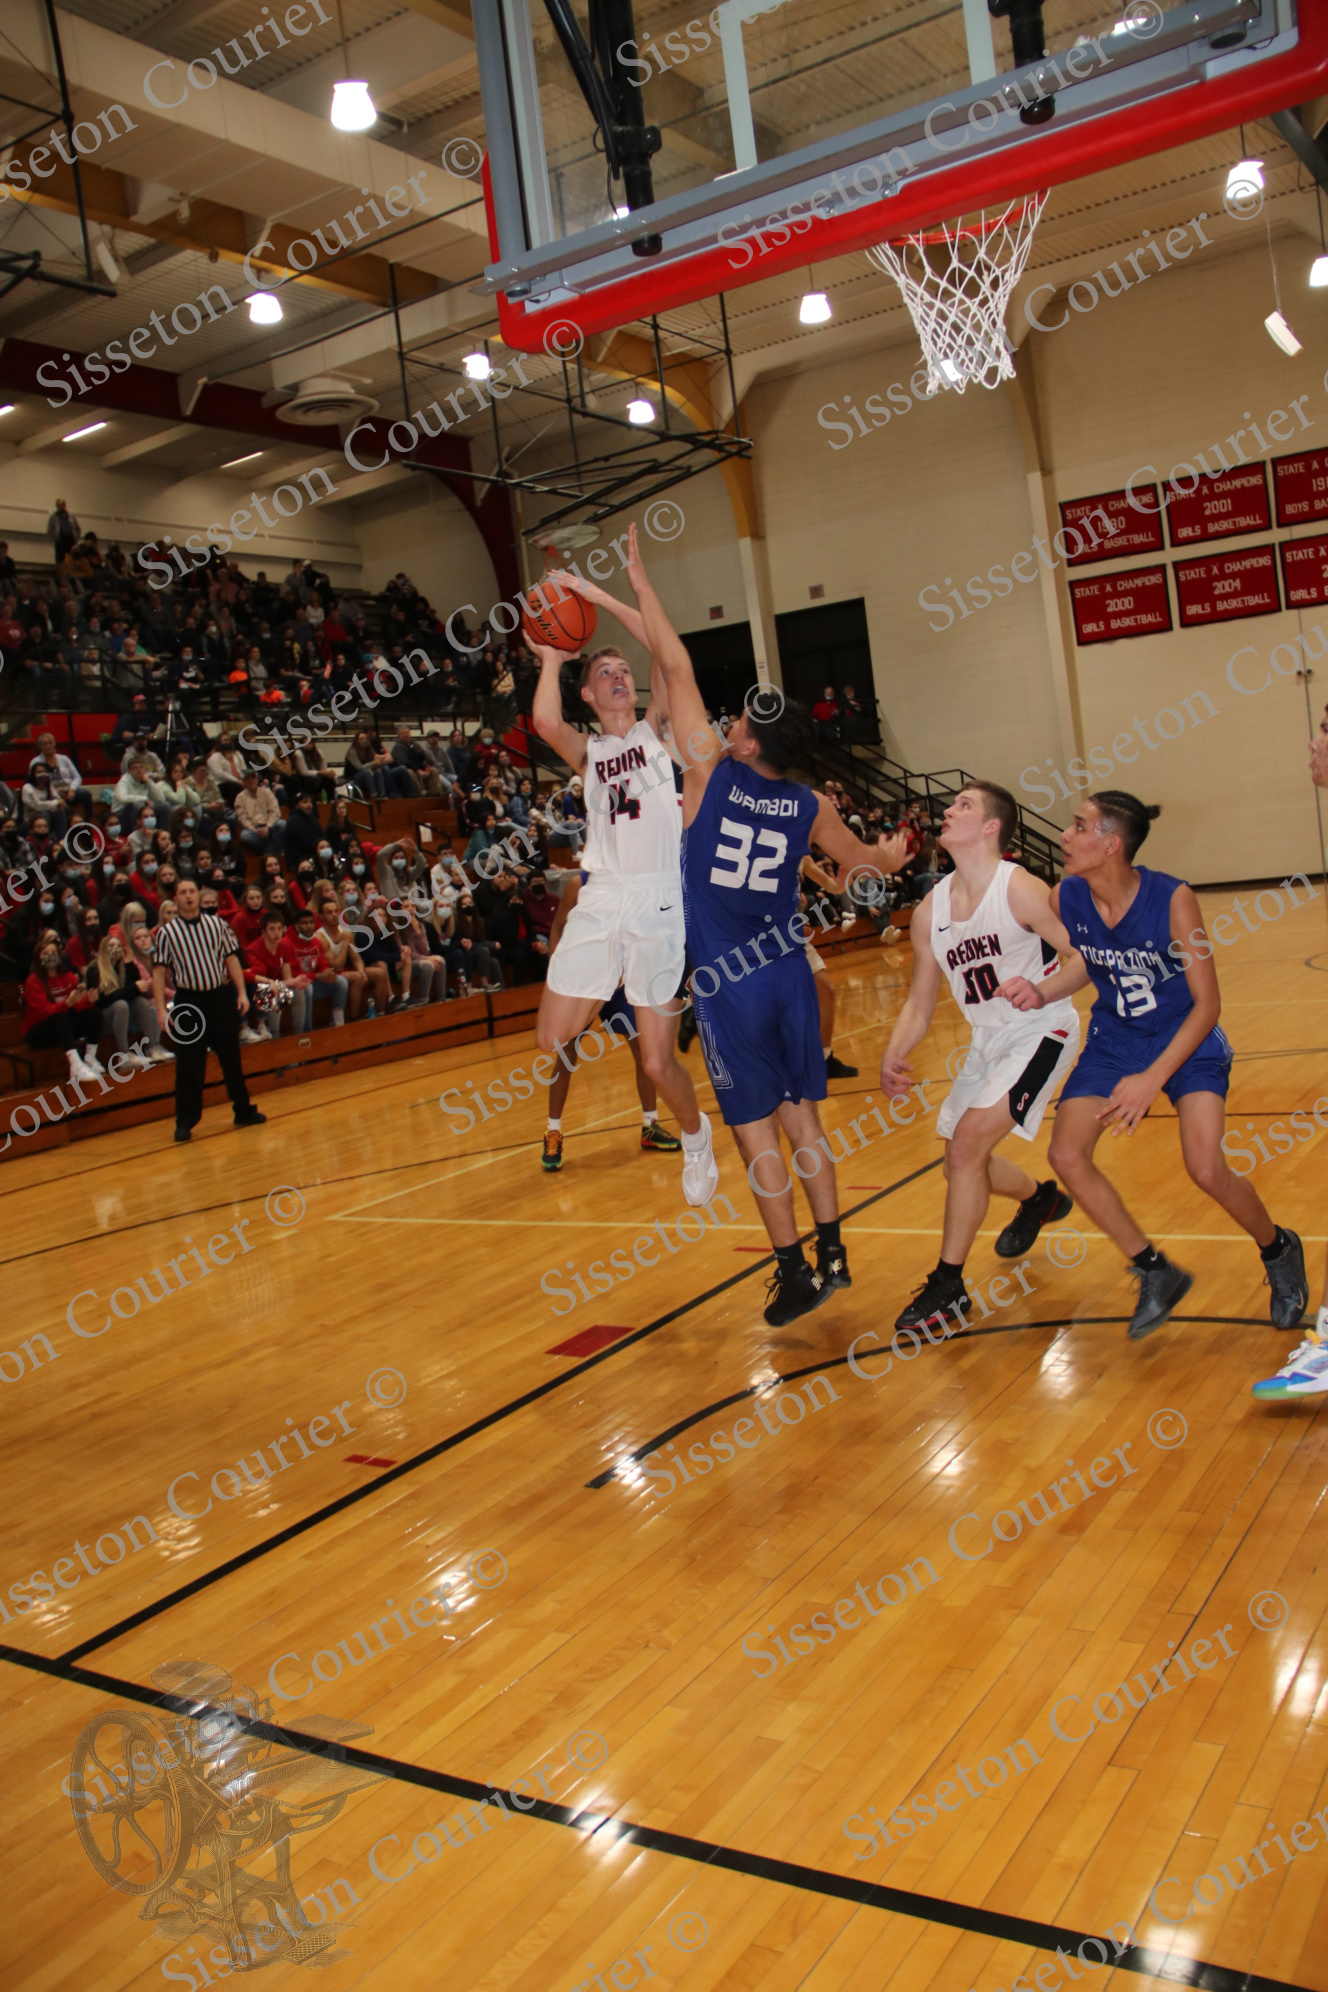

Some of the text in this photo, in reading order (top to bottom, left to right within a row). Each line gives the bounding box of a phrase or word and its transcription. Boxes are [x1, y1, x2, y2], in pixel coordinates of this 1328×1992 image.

[1277, 463, 1305, 476] STATE
[1169, 488, 1196, 502] STATE
[1214, 474, 1263, 493] CHAMPIONS
[1066, 506, 1091, 519] STATE
[1108, 493, 1154, 511] CHAIONS
[1203, 498, 1232, 515] 2001
[1285, 501, 1309, 514] BOYS
[1178, 514, 1262, 538] GIRLS BASKETBALL
[1074, 532, 1155, 554] GRLS BASKETBALL
[1285, 548, 1314, 562] STATE
[1179, 567, 1206, 581] STATE
[1224, 555, 1272, 573] CHAMPIONS
[1075, 585, 1099, 598] STATE
[1117, 573, 1162, 591] CHAMPIONS
[1212, 578, 1241, 595] 2004
[1290, 587, 1317, 601] GIRLS
[1106, 596, 1134, 612] 2000
[1186, 593, 1271, 616] GIRLS BASKETBALL
[1082, 612, 1163, 634] GIRLS BASKETBALL
[608, 779, 641, 825] 14
[728, 785, 798, 818] WAMBDI
[710, 816, 788, 894] 32
[1109, 973, 1158, 1017] 13
